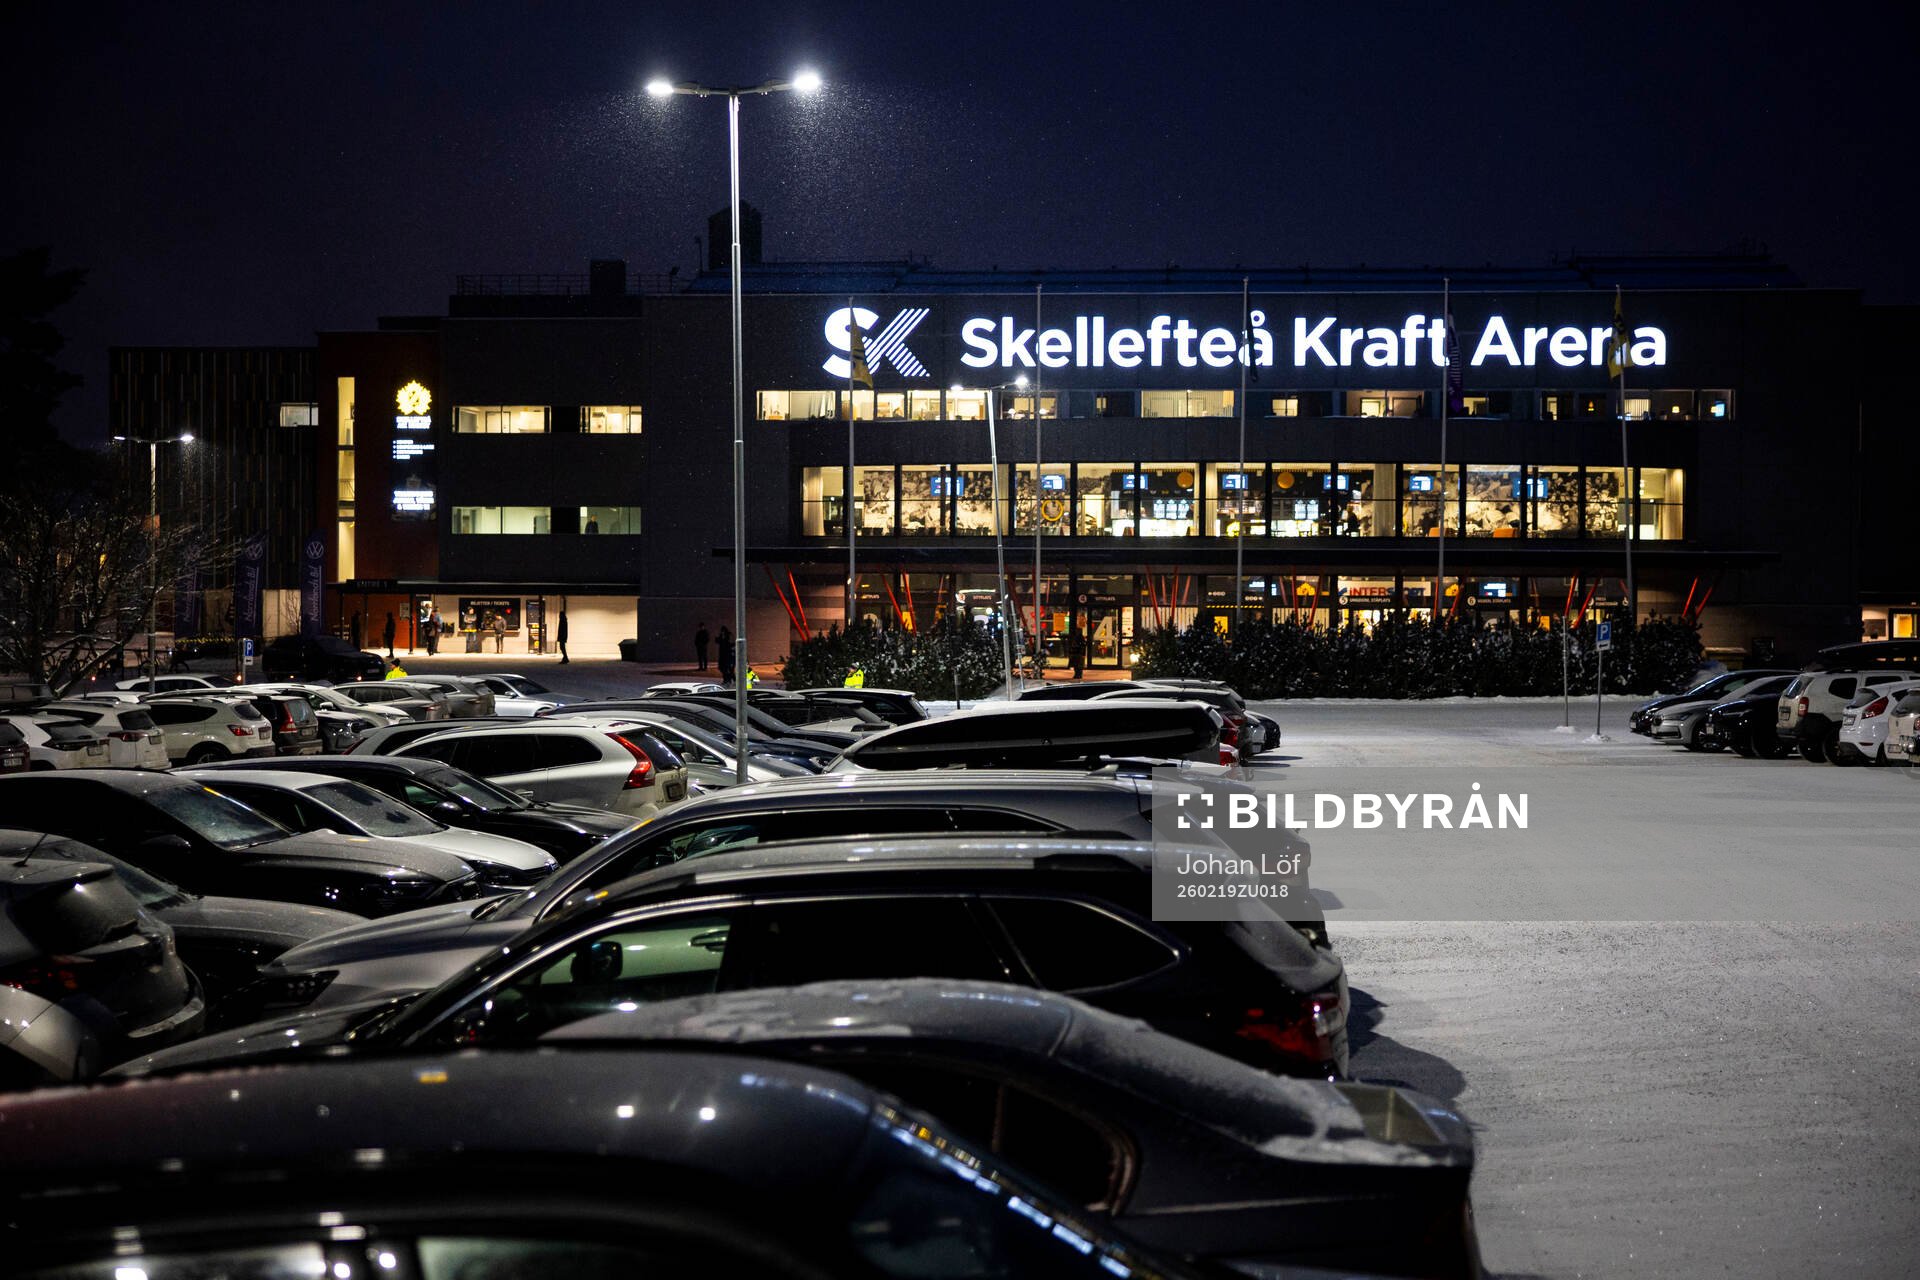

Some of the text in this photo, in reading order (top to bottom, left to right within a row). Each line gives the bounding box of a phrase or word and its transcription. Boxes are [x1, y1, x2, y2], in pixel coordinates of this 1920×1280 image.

[961, 310, 1273, 367] Skellefteå
[1294, 314, 1450, 367] Kraft
[1093, 616, 1116, 647] 4
